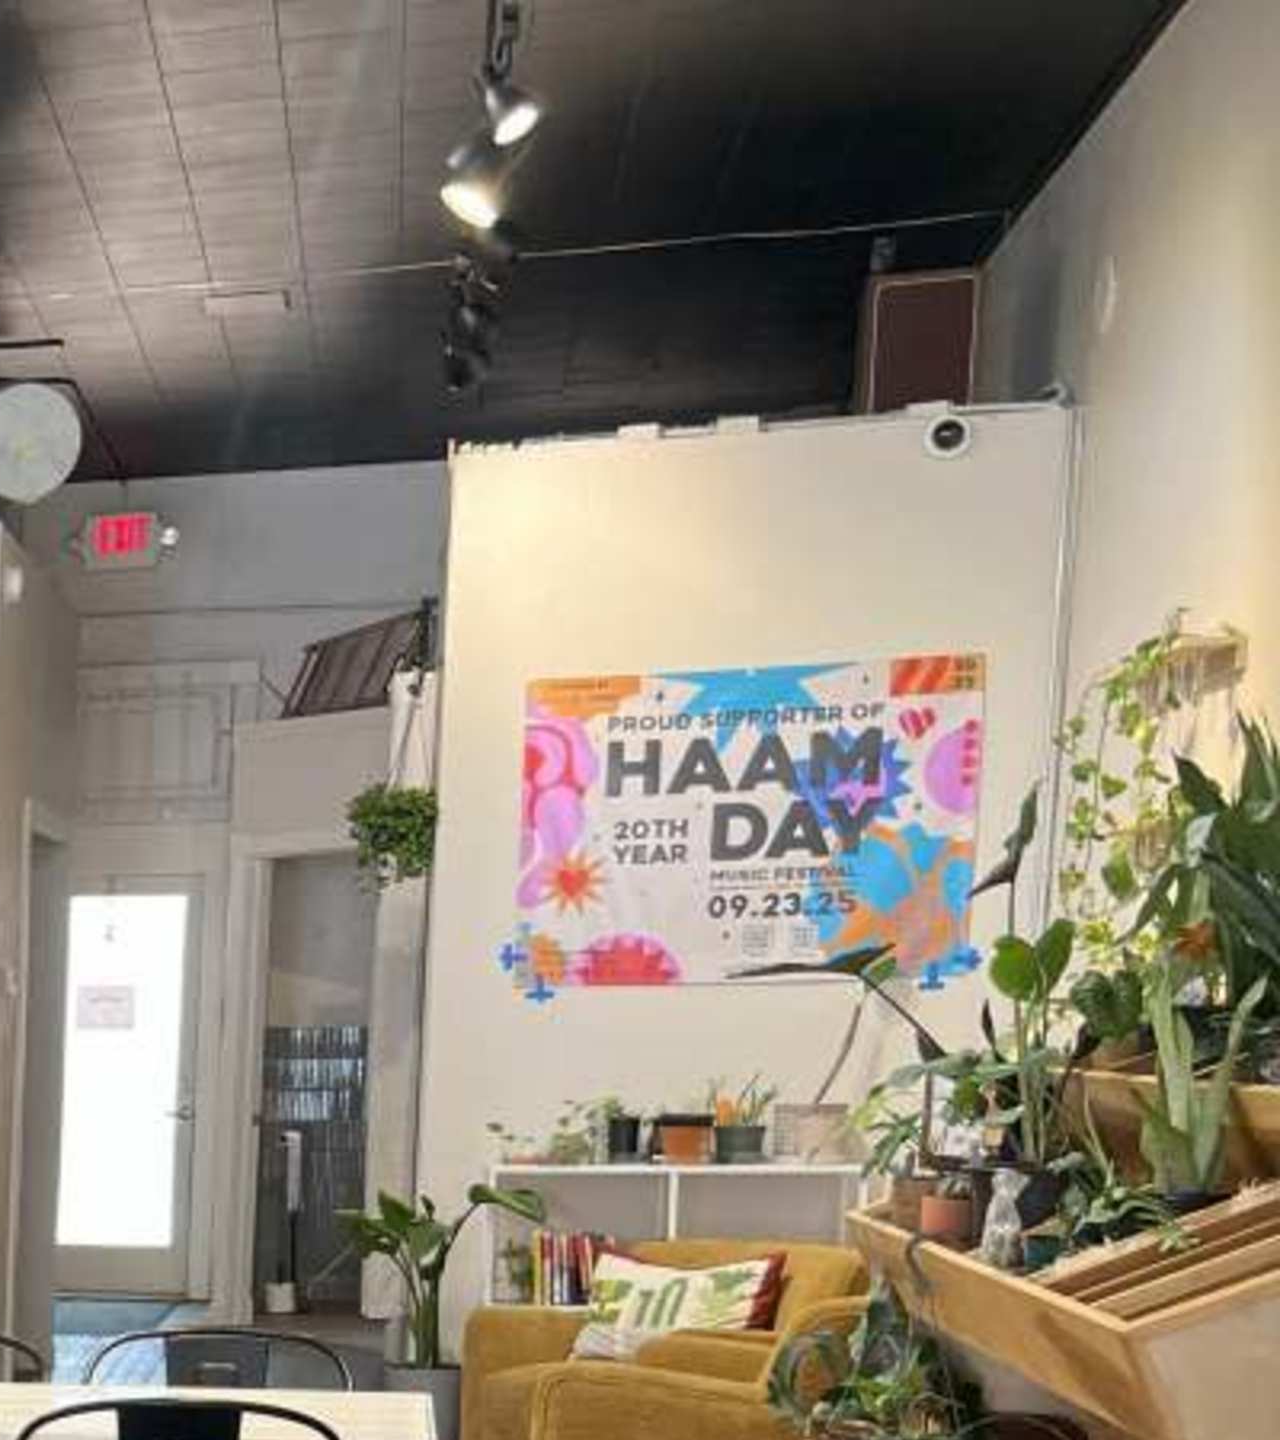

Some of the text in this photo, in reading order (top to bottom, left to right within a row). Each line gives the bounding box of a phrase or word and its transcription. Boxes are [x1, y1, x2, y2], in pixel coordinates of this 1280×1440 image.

[606, 704, 885, 732] PROUD SUPPORTER OF
[605, 727, 884, 797] HAAM
[613, 819, 689, 841] 20TH
[710, 801, 874, 861] DAY
[613, 844, 688, 866] YEAR
[709, 890, 856, 918] 09.23.25
